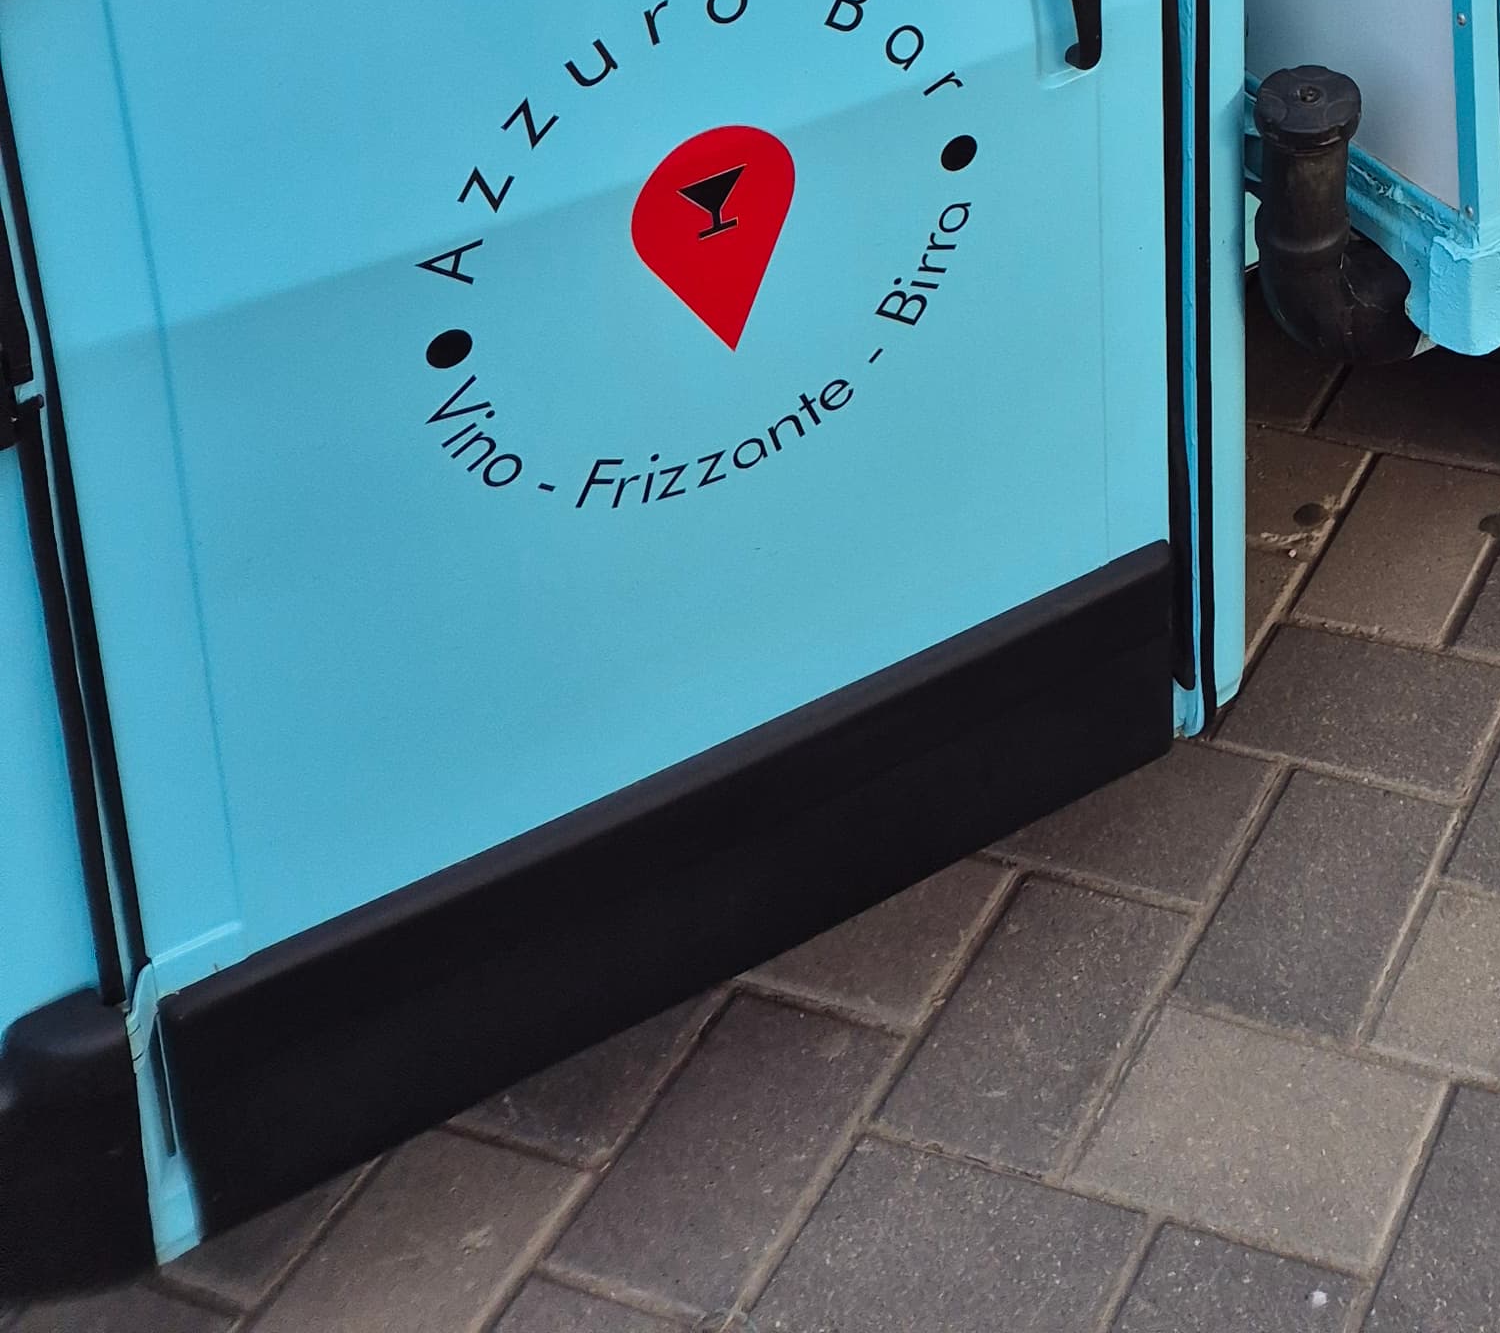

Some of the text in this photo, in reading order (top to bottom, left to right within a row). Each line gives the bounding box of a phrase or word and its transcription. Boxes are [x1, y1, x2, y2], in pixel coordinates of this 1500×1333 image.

[425, 375, 523, 488] Vino
[575, 378, 855, 509] Frizzante
[875, 201, 972, 326] Birra
